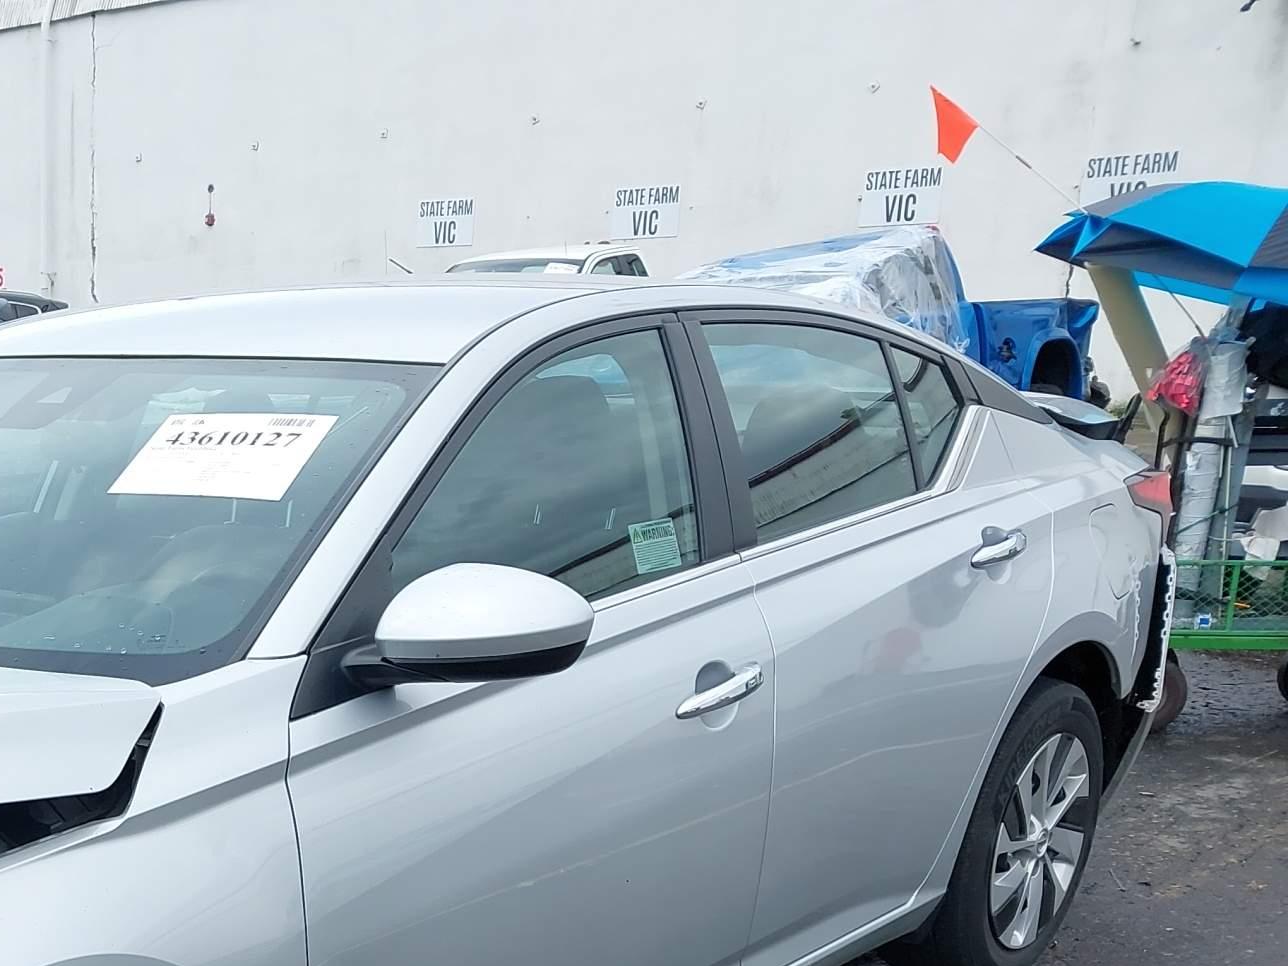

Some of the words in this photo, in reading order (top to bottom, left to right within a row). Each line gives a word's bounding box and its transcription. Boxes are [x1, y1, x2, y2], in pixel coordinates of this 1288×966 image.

[1087, 155, 1130, 179] STATE
[1133, 151, 1179, 175] FARM
[866, 170, 901, 190] STATE
[904, 167, 942, 188] FARM
[420, 200, 445, 217] STATE
[447, 199, 473, 216] FARM
[616, 188, 646, 207] STATE
[648, 186, 679, 205] FARM
[885, 193, 917, 222] VIC
[434, 220, 457, 244] VIC
[632, 210, 659, 236] VIC
[165, 430, 303, 448] 43610127
